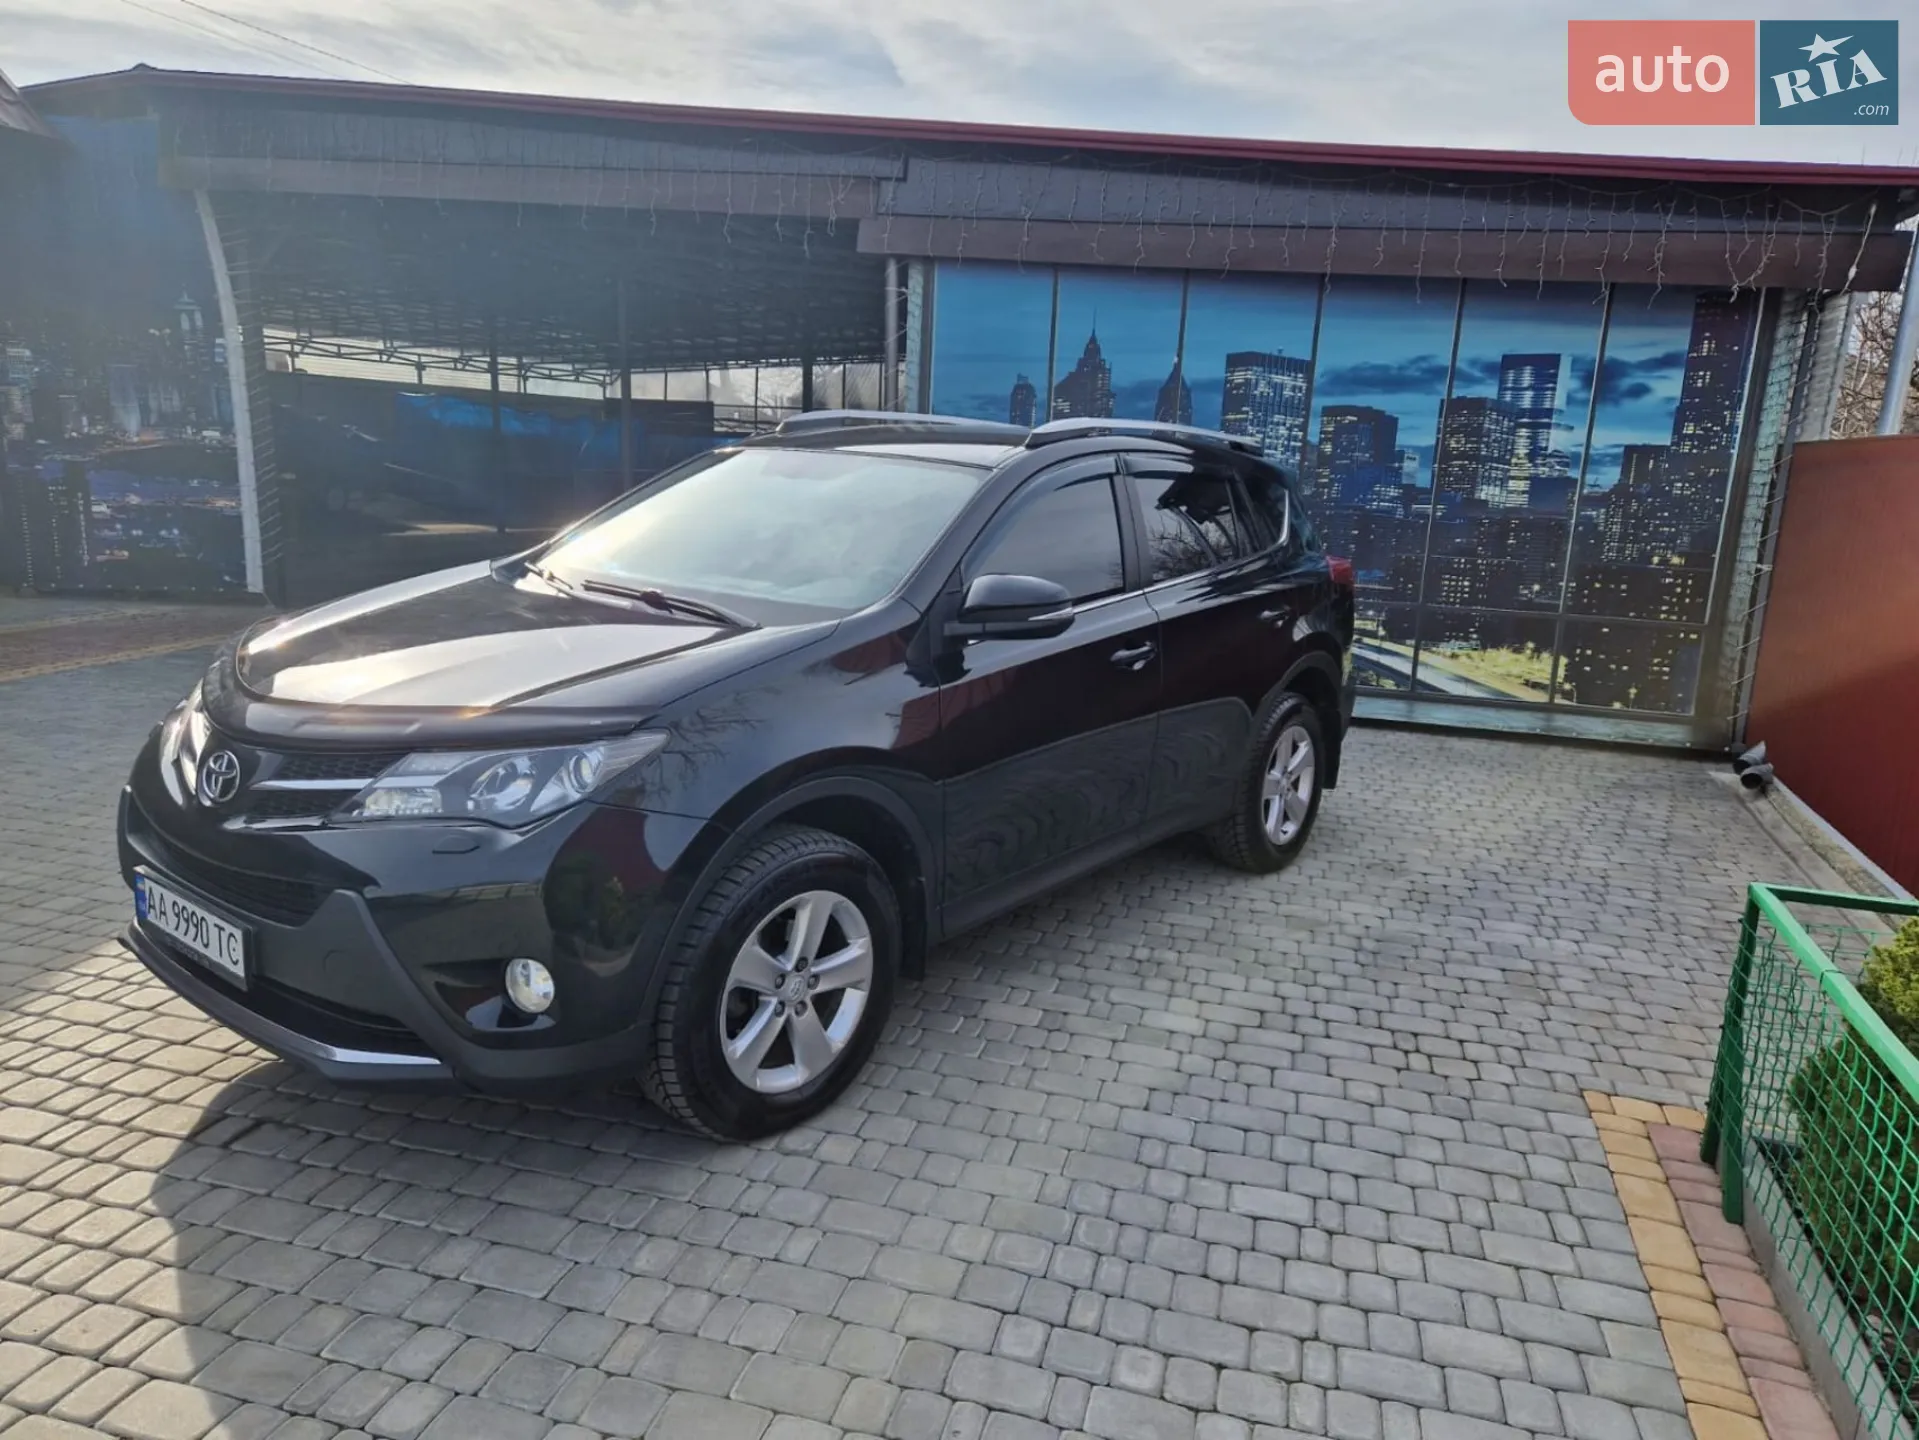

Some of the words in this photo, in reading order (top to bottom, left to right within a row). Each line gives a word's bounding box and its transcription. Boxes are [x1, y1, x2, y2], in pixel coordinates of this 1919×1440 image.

[148, 887, 169, 926] AA
[172, 901, 210, 949] 9990
[213, 923, 239, 965] TC
